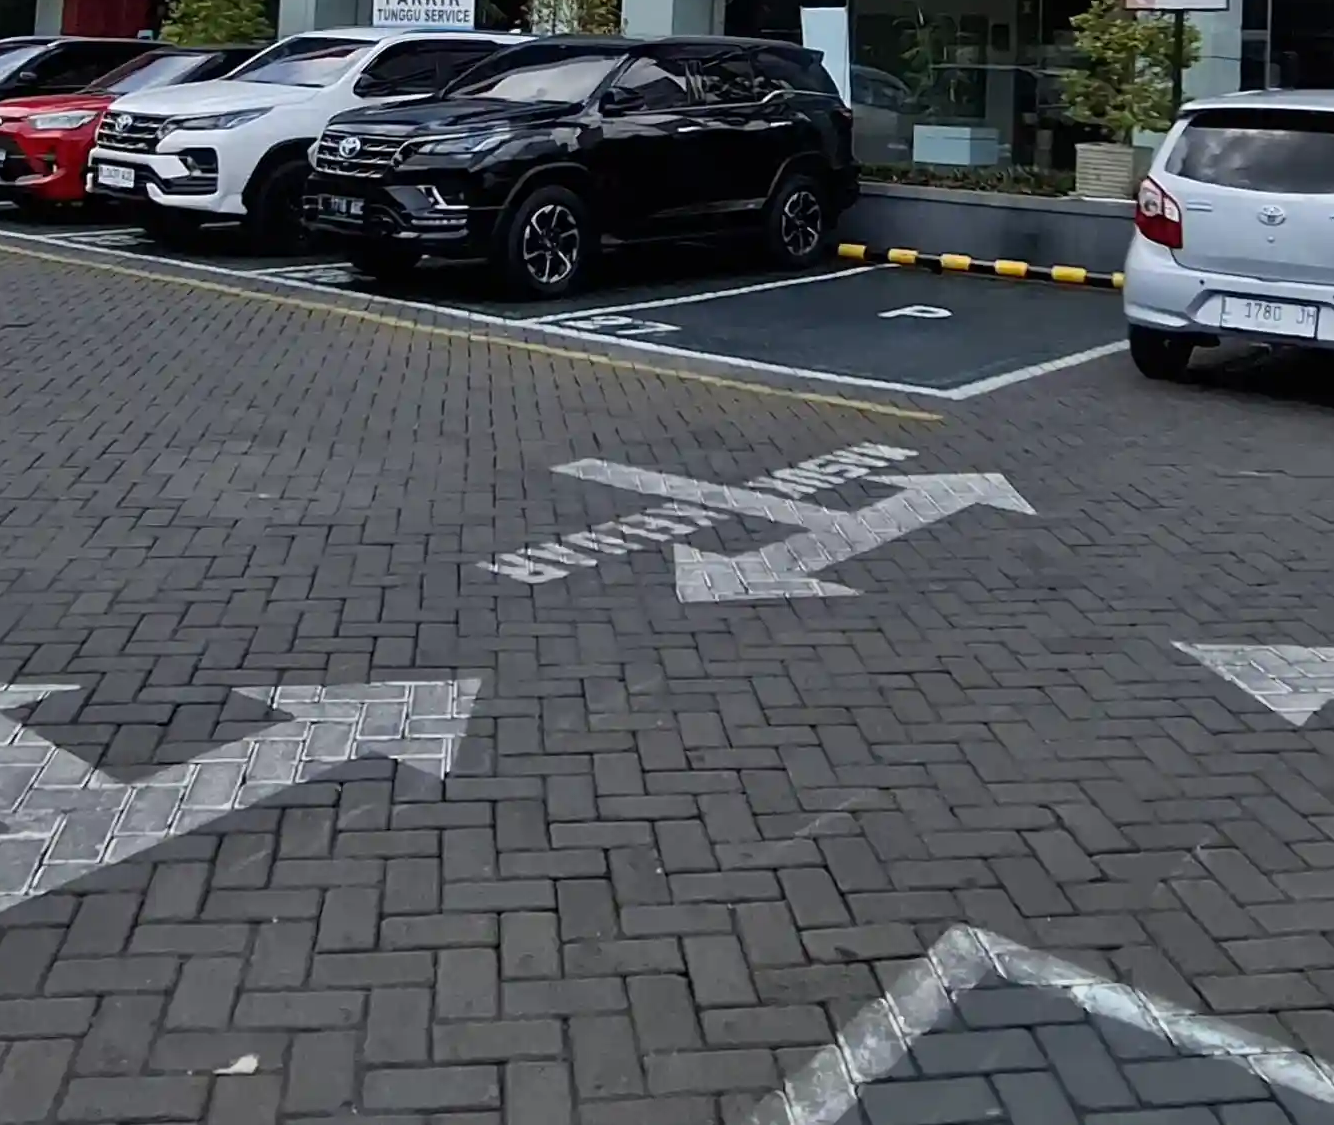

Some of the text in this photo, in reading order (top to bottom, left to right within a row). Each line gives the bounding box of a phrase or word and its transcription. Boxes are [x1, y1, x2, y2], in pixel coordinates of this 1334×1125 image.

[377, 8, 471, 23] TUNGGU SERVICE
[877, 304, 953, 319] P
[1245, 302, 1283, 322] 1780
[476, 501, 731, 585] KELUAR
